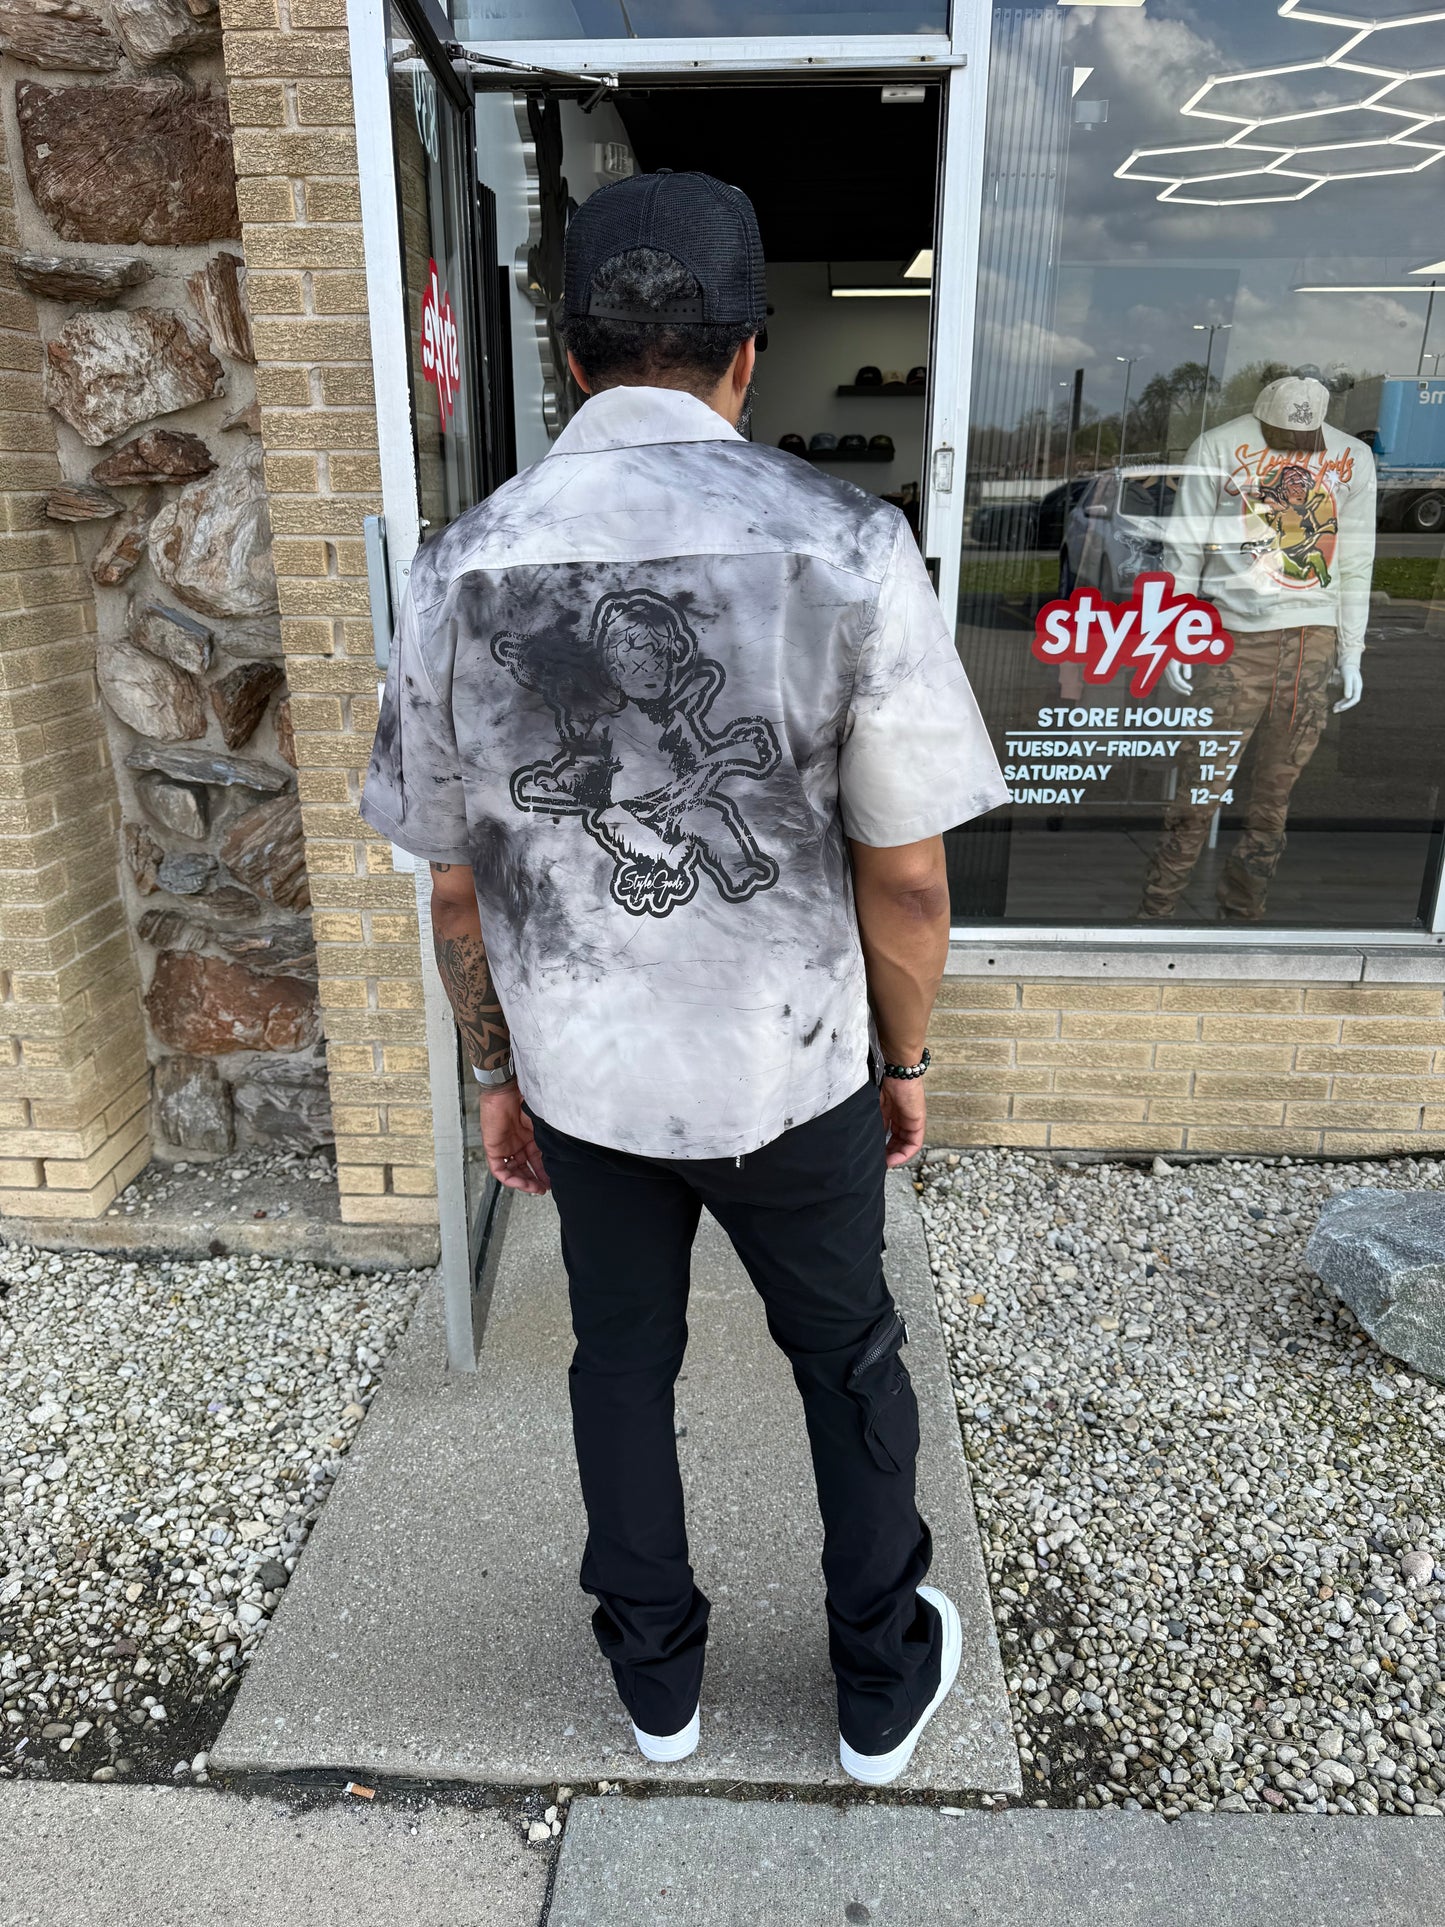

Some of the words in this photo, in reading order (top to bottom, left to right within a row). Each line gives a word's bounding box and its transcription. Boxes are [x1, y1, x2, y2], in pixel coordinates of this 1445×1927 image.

[1038, 707, 1118, 728] STORE
[1124, 707, 1214, 728] HOURS
[1198, 740, 1241, 758] 12-7
[1003, 764, 1112, 781] SATURDAY
[1200, 764, 1238, 781] 11-7
[1008, 788, 1086, 804] SUNDAY
[1190, 788, 1234, 805] 12-4
